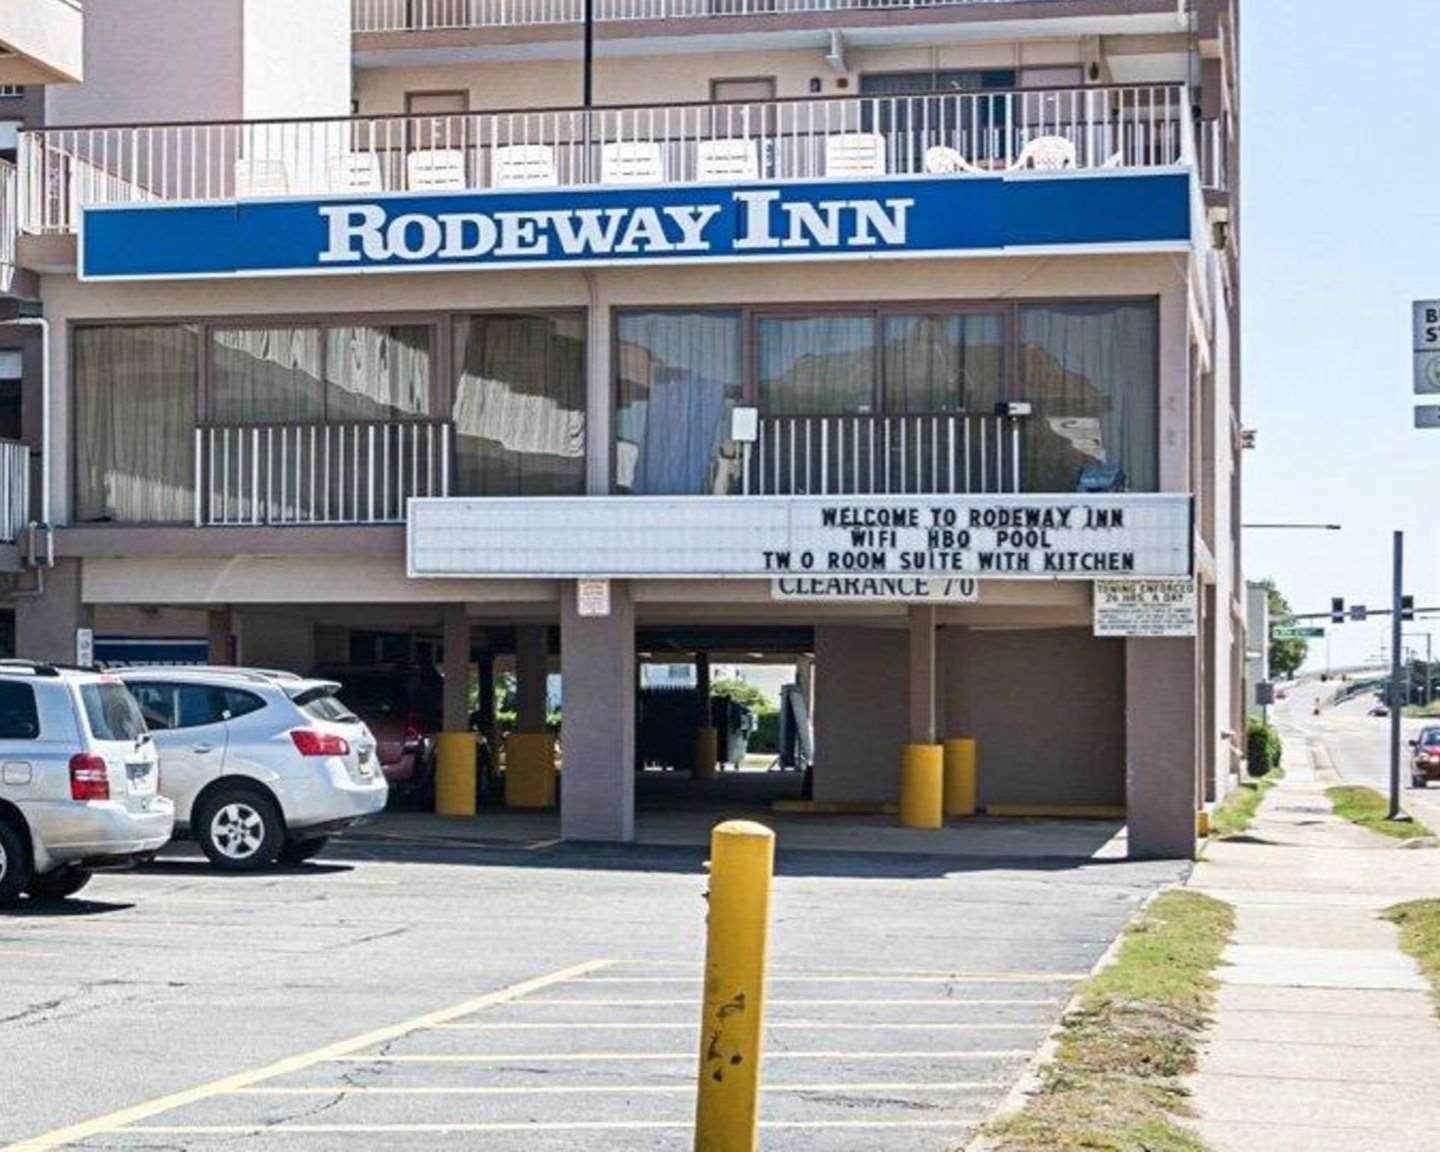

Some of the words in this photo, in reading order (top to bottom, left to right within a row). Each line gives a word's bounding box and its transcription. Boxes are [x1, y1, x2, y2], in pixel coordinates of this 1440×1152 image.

[318, 204, 721, 262] RODEWAY
[732, 190, 914, 249] INN
[822, 507, 919, 527] WELCOME
[931, 508, 957, 527] TO
[969, 508, 1071, 528] RODEWAY
[1085, 508, 1123, 528] INN
[851, 530, 897, 548] WIFI
[928, 530, 970, 548] HBO
[996, 530, 1052, 548] POOL
[828, 551, 886, 570] ROOM
[900, 551, 963, 570] SUITE
[978, 552, 1030, 571] WITH
[1044, 552, 1134, 571] KITCHEN
[778, 578, 929, 596] CLEARANCE
